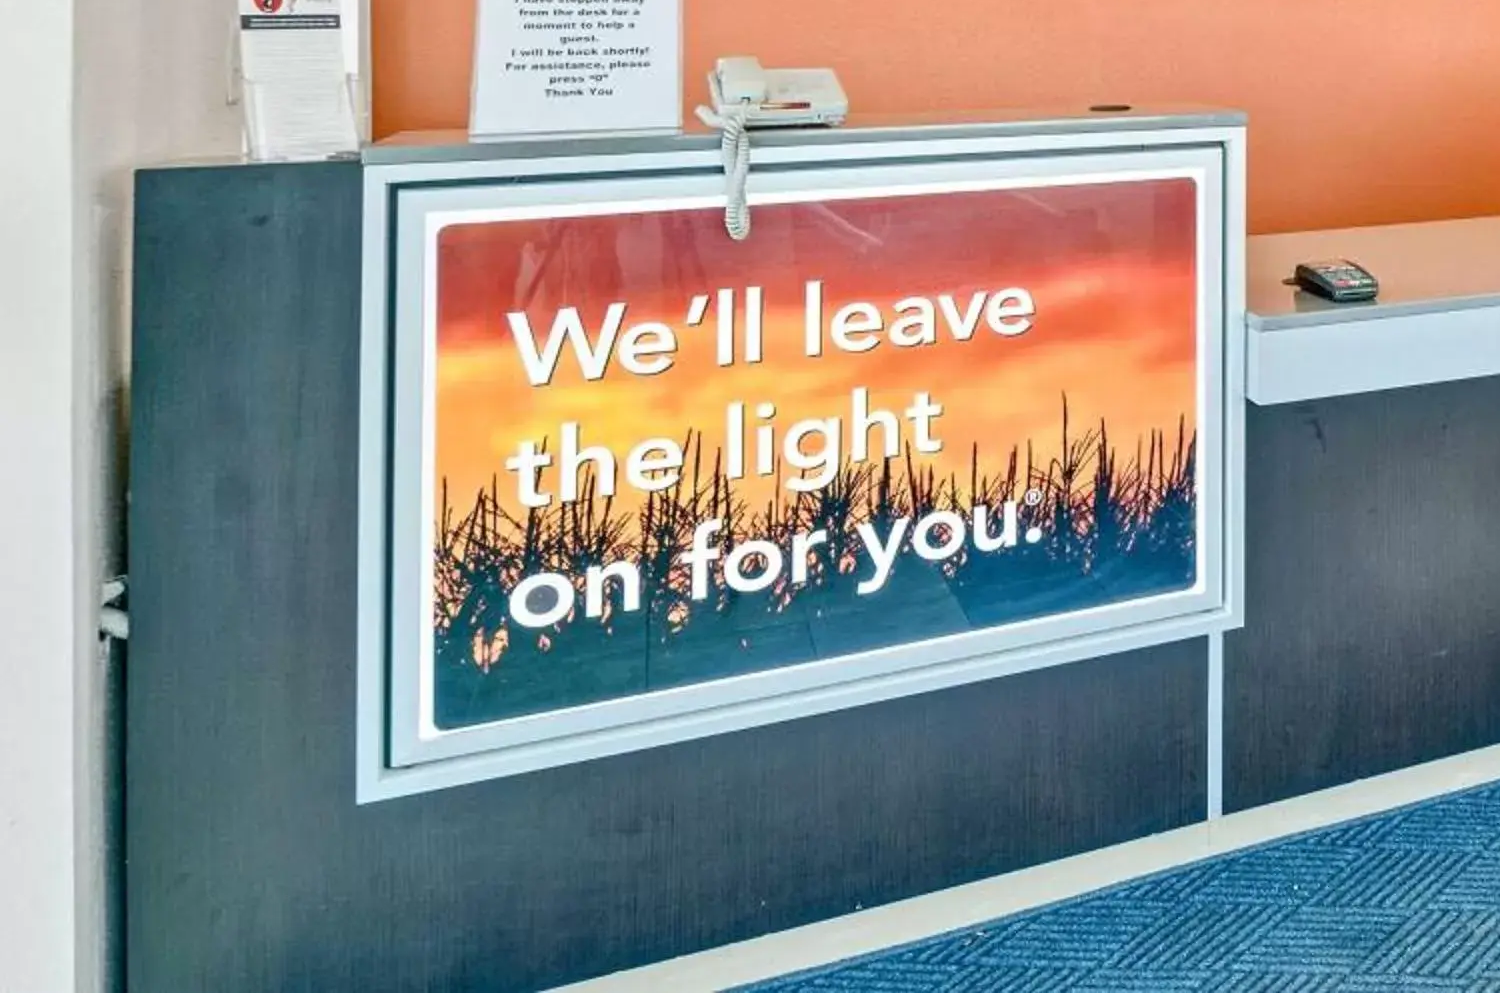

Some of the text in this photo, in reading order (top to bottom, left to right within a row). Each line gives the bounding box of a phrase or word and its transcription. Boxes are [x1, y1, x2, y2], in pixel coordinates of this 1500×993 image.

[519, 8, 549, 16] from
[553, 8, 574, 16] the
[577, 8, 608, 16] desk
[611, 7, 628, 16] for
[597, 21, 625, 31] help
[559, 34, 600, 45] guest.
[519, 48, 543, 56] will
[547, 48, 564, 56] be
[567, 48, 598, 56] back
[505, 60, 651, 71] For assistance, please
[548, 75, 585, 85] press
[544, 87, 614, 98] Thank You
[506, 280, 1036, 387] We'll leave
[505, 386, 945, 509] the light
[507, 559, 642, 629] on
[683, 517, 826, 602] for
